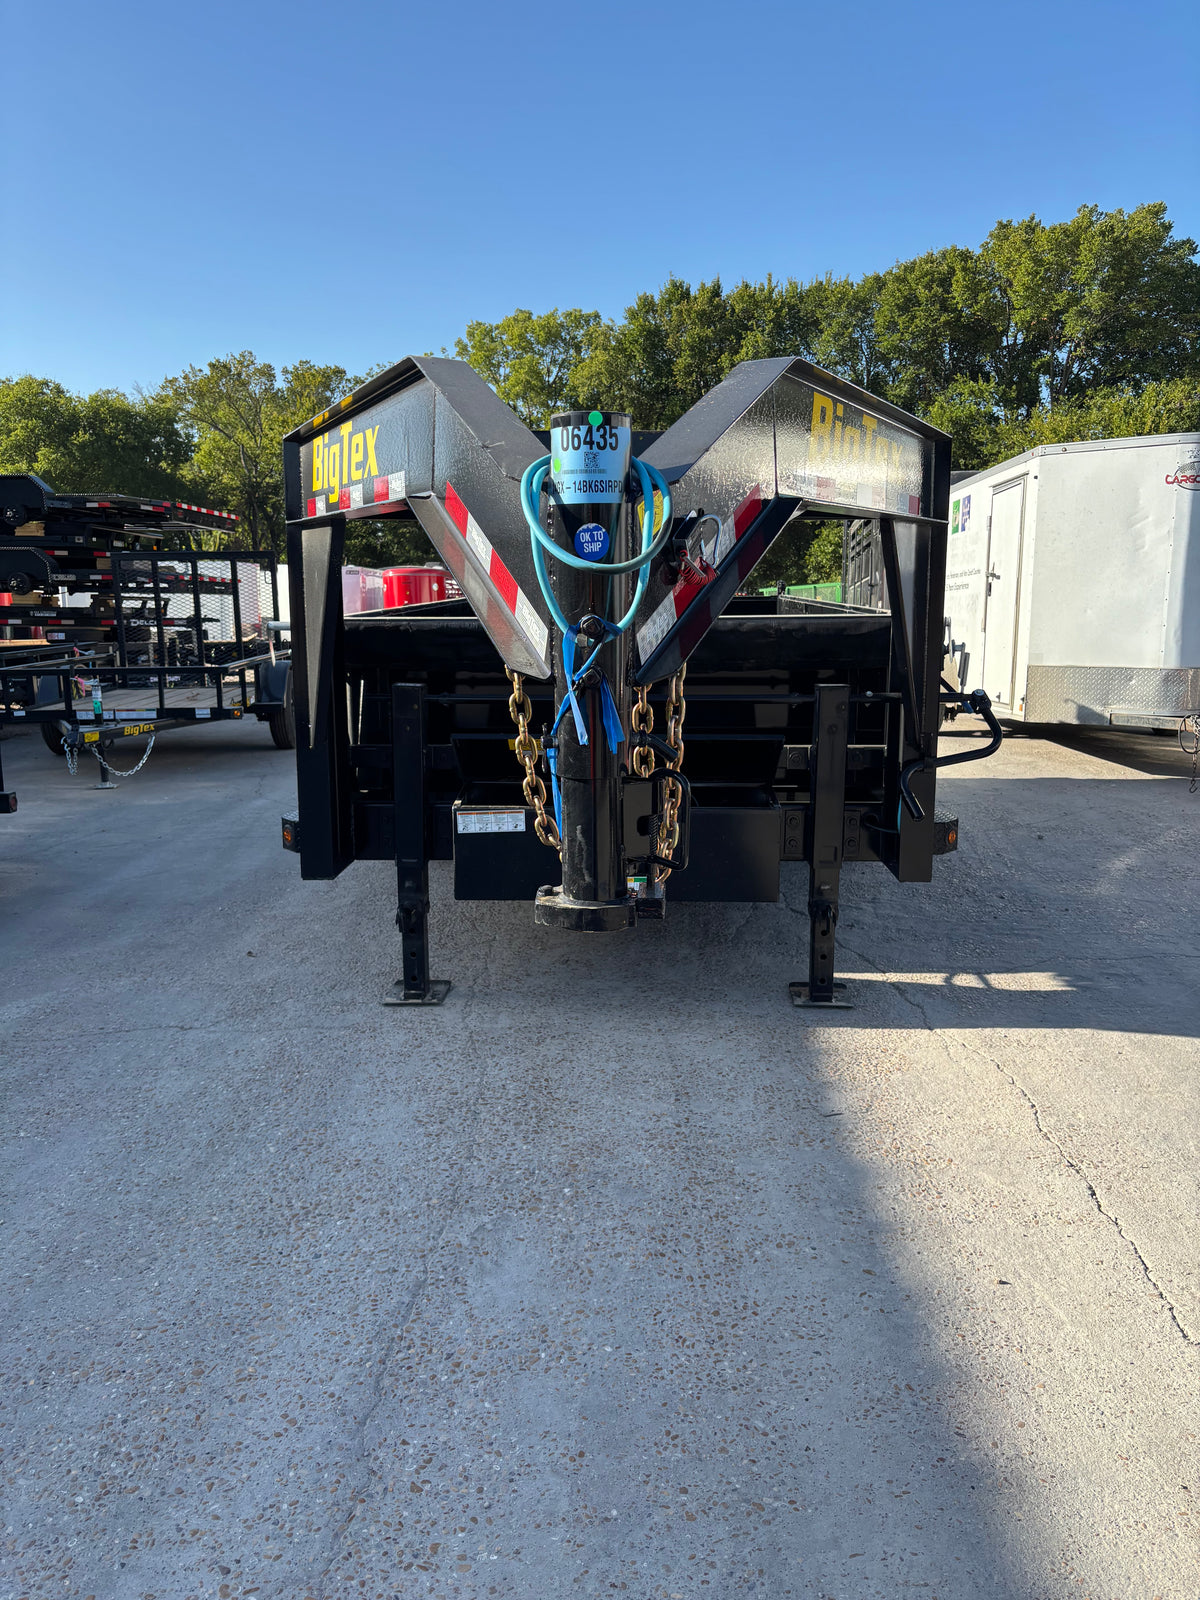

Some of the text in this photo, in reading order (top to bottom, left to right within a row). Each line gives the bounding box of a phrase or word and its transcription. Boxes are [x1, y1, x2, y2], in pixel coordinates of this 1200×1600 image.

[560, 425, 619, 452] 06435
[312, 420, 380, 504] BigTex
[579, 530, 604, 543] OK TO
[583, 541, 602, 553] SHIP
[123, 723, 155, 737] BigTex
